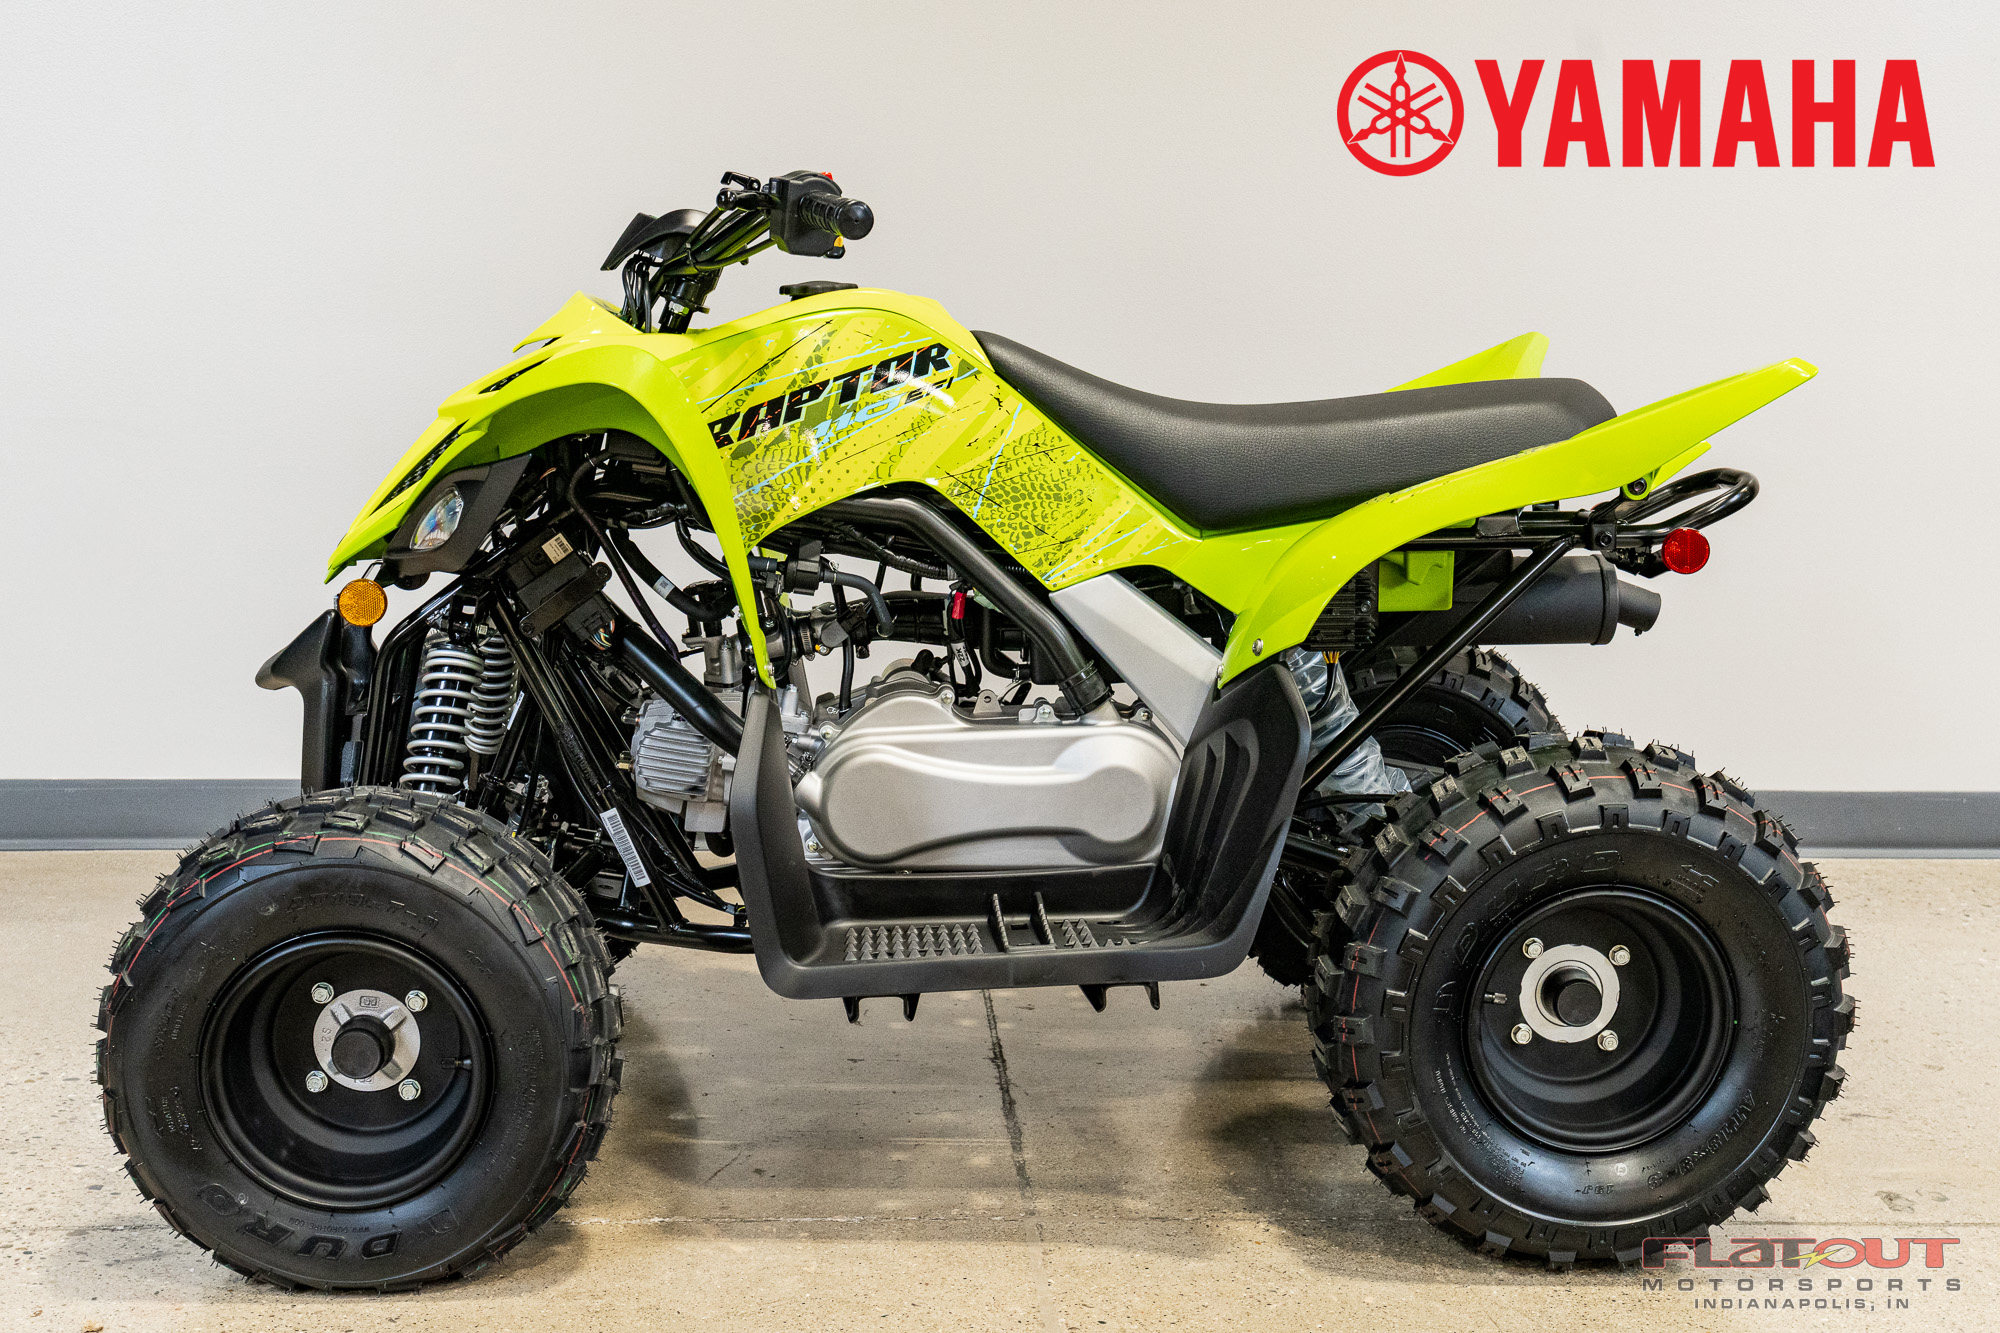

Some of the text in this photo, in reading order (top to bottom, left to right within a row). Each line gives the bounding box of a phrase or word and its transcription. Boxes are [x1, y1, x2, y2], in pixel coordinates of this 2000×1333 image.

[707, 342, 953, 448] RAPTOR
[812, 390, 908, 440] 110
[196, 1182, 402, 1262] DURO
